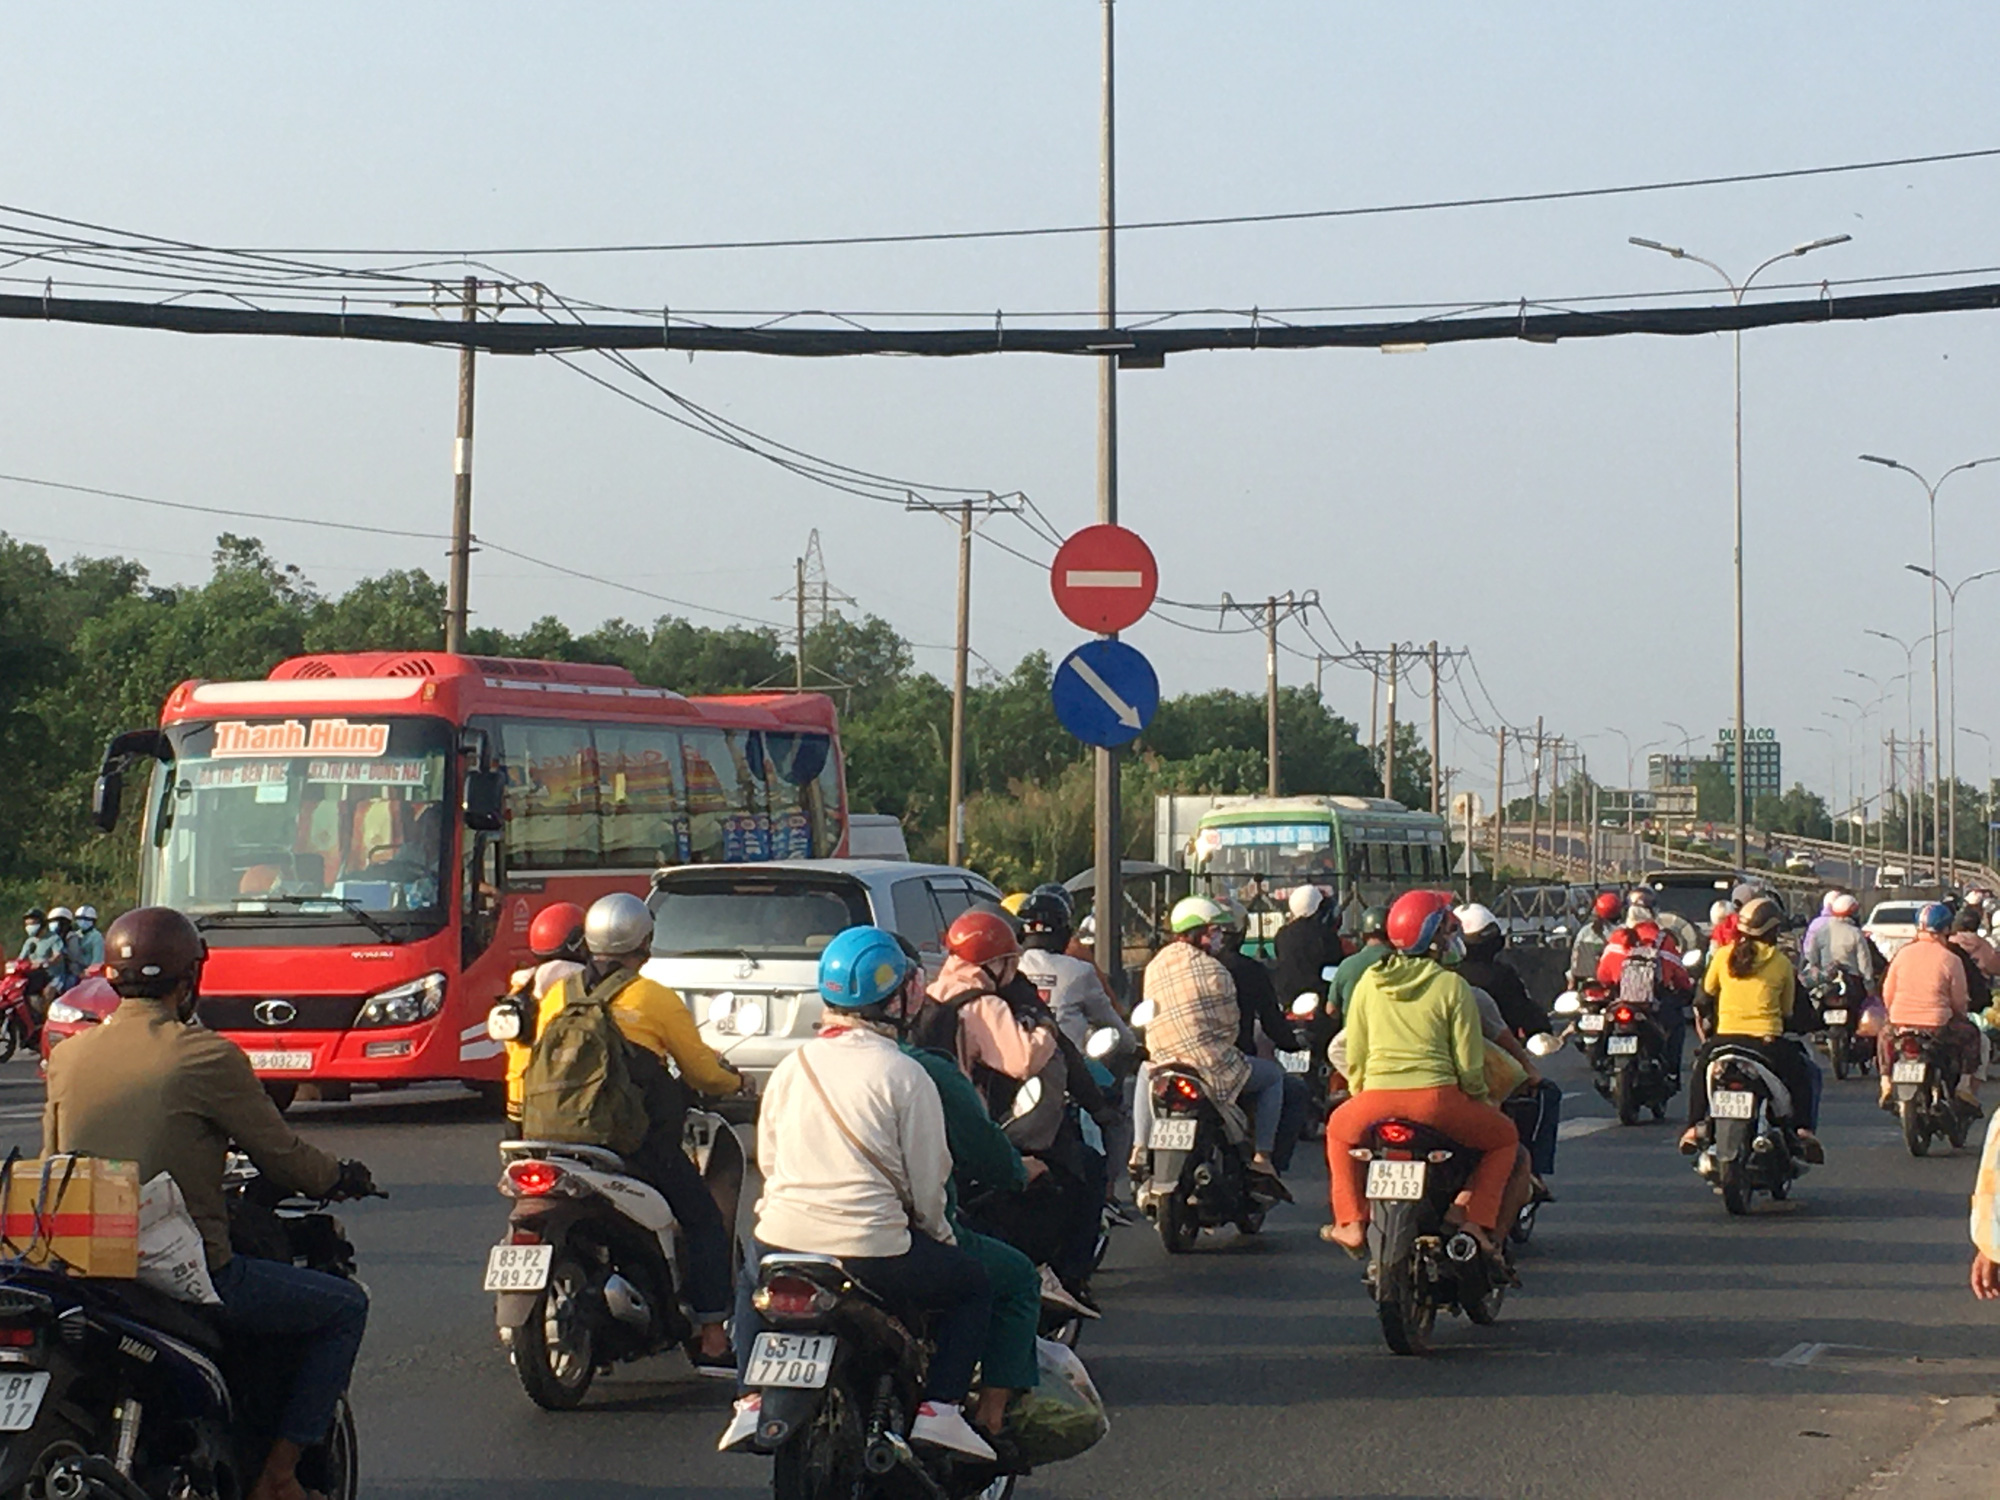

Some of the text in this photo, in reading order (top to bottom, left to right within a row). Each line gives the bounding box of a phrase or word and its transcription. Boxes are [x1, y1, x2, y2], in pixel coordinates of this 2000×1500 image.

[217, 719, 387, 751] Thanh Hùng
[1369, 1180, 1420, 1197] 371.63
[499, 1248, 542, 1267] 83-P2
[487, 1268, 545, 1288] 289.27
[118, 1334, 158, 1362] YAMAHA
[758, 1360, 818, 1384] 7700
